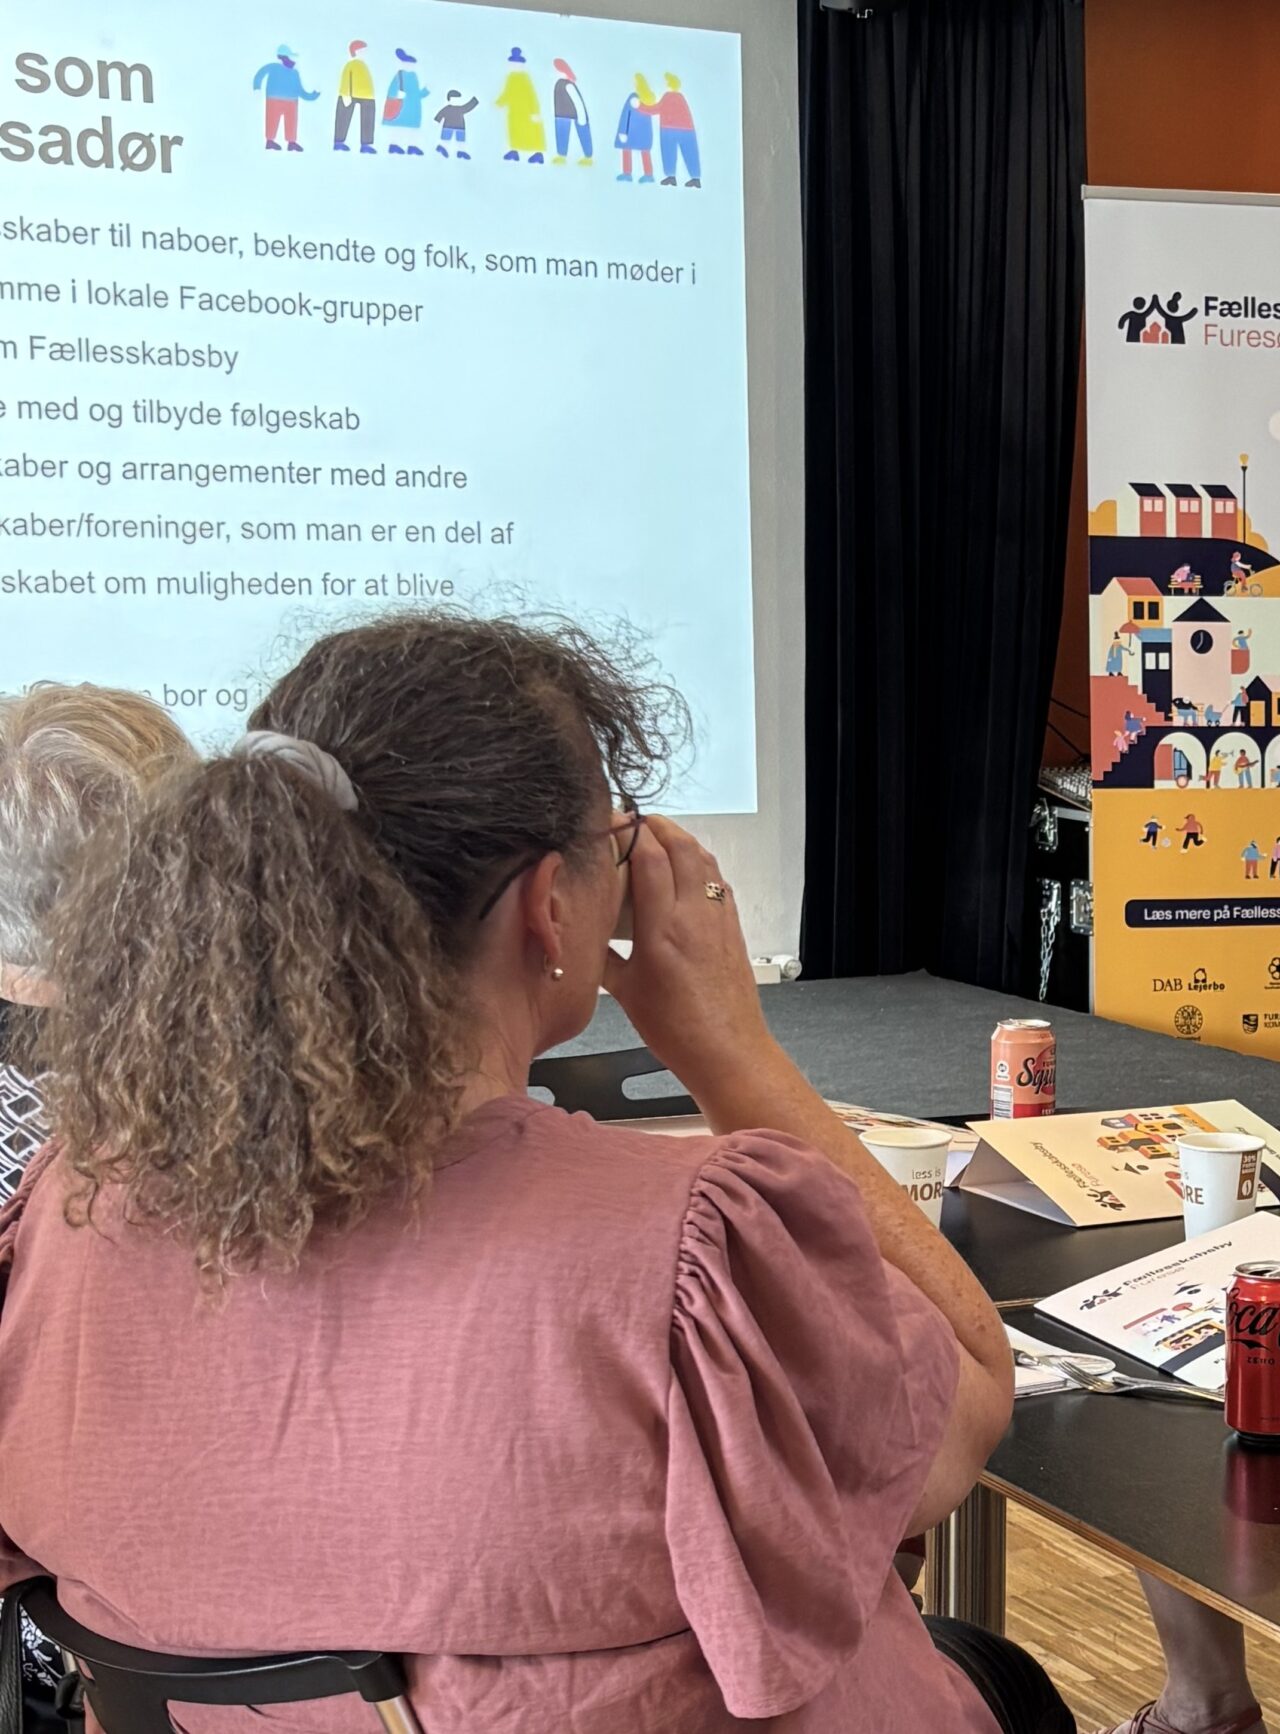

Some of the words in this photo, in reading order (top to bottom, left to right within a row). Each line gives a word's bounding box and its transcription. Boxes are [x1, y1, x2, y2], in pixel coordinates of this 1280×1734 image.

[15, 52, 154, 103] som
[0, 116, 184, 173] sadør
[108, 223, 131, 248] til
[142, 227, 243, 259] naboer,
[254, 232, 376, 263] bekendte
[385, 247, 415, 272] og
[424, 243, 475, 274] folk,
[485, 254, 536, 274] som
[546, 258, 597, 278] man
[608, 260, 684, 285] møder
[690, 262, 697, 285] i
[70, 279, 77, 303] i
[88, 280, 169, 308] lokale
[180, 286, 423, 326] Facebook-grupper
[29, 335, 239, 375] Fællesskabsby
[17, 396, 78, 421] med
[89, 403, 122, 428] og
[132, 399, 221, 431] tilbyde
[230, 402, 360, 434] følgeskab
[0, 452, 69, 478] aber
[78, 461, 111, 485] og
[122, 461, 322, 488] arrangementer
[331, 463, 385, 486] med
[395, 465, 467, 488] andre
[241, 522, 296, 541] som
[307, 523, 361, 542] man
[371, 524, 397, 543] er
[405, 525, 435, 543] en
[445, 520, 481, 544] del
[491, 522, 514, 545] af
[2, 569, 96, 594] skabet
[105, 576, 146, 594] om
[157, 571, 312, 601] muligheden
[321, 572, 356, 596] for
[365, 574, 388, 596] at
[397, 573, 454, 597] blive
[163, 684, 207, 706] bor
[216, 689, 248, 712] og
[1144, 908, 1172, 920] Læs
[1176, 909, 1211, 920] mere
[1214, 905, 1230, 921] på
[1153, 978, 1183, 992] DAB
[1188, 982, 1225, 992] Lejerbo
[912, 1169, 933, 1180] less
[935, 1166, 941, 1177] is
[1184, 1185, 1204, 1205] RE
